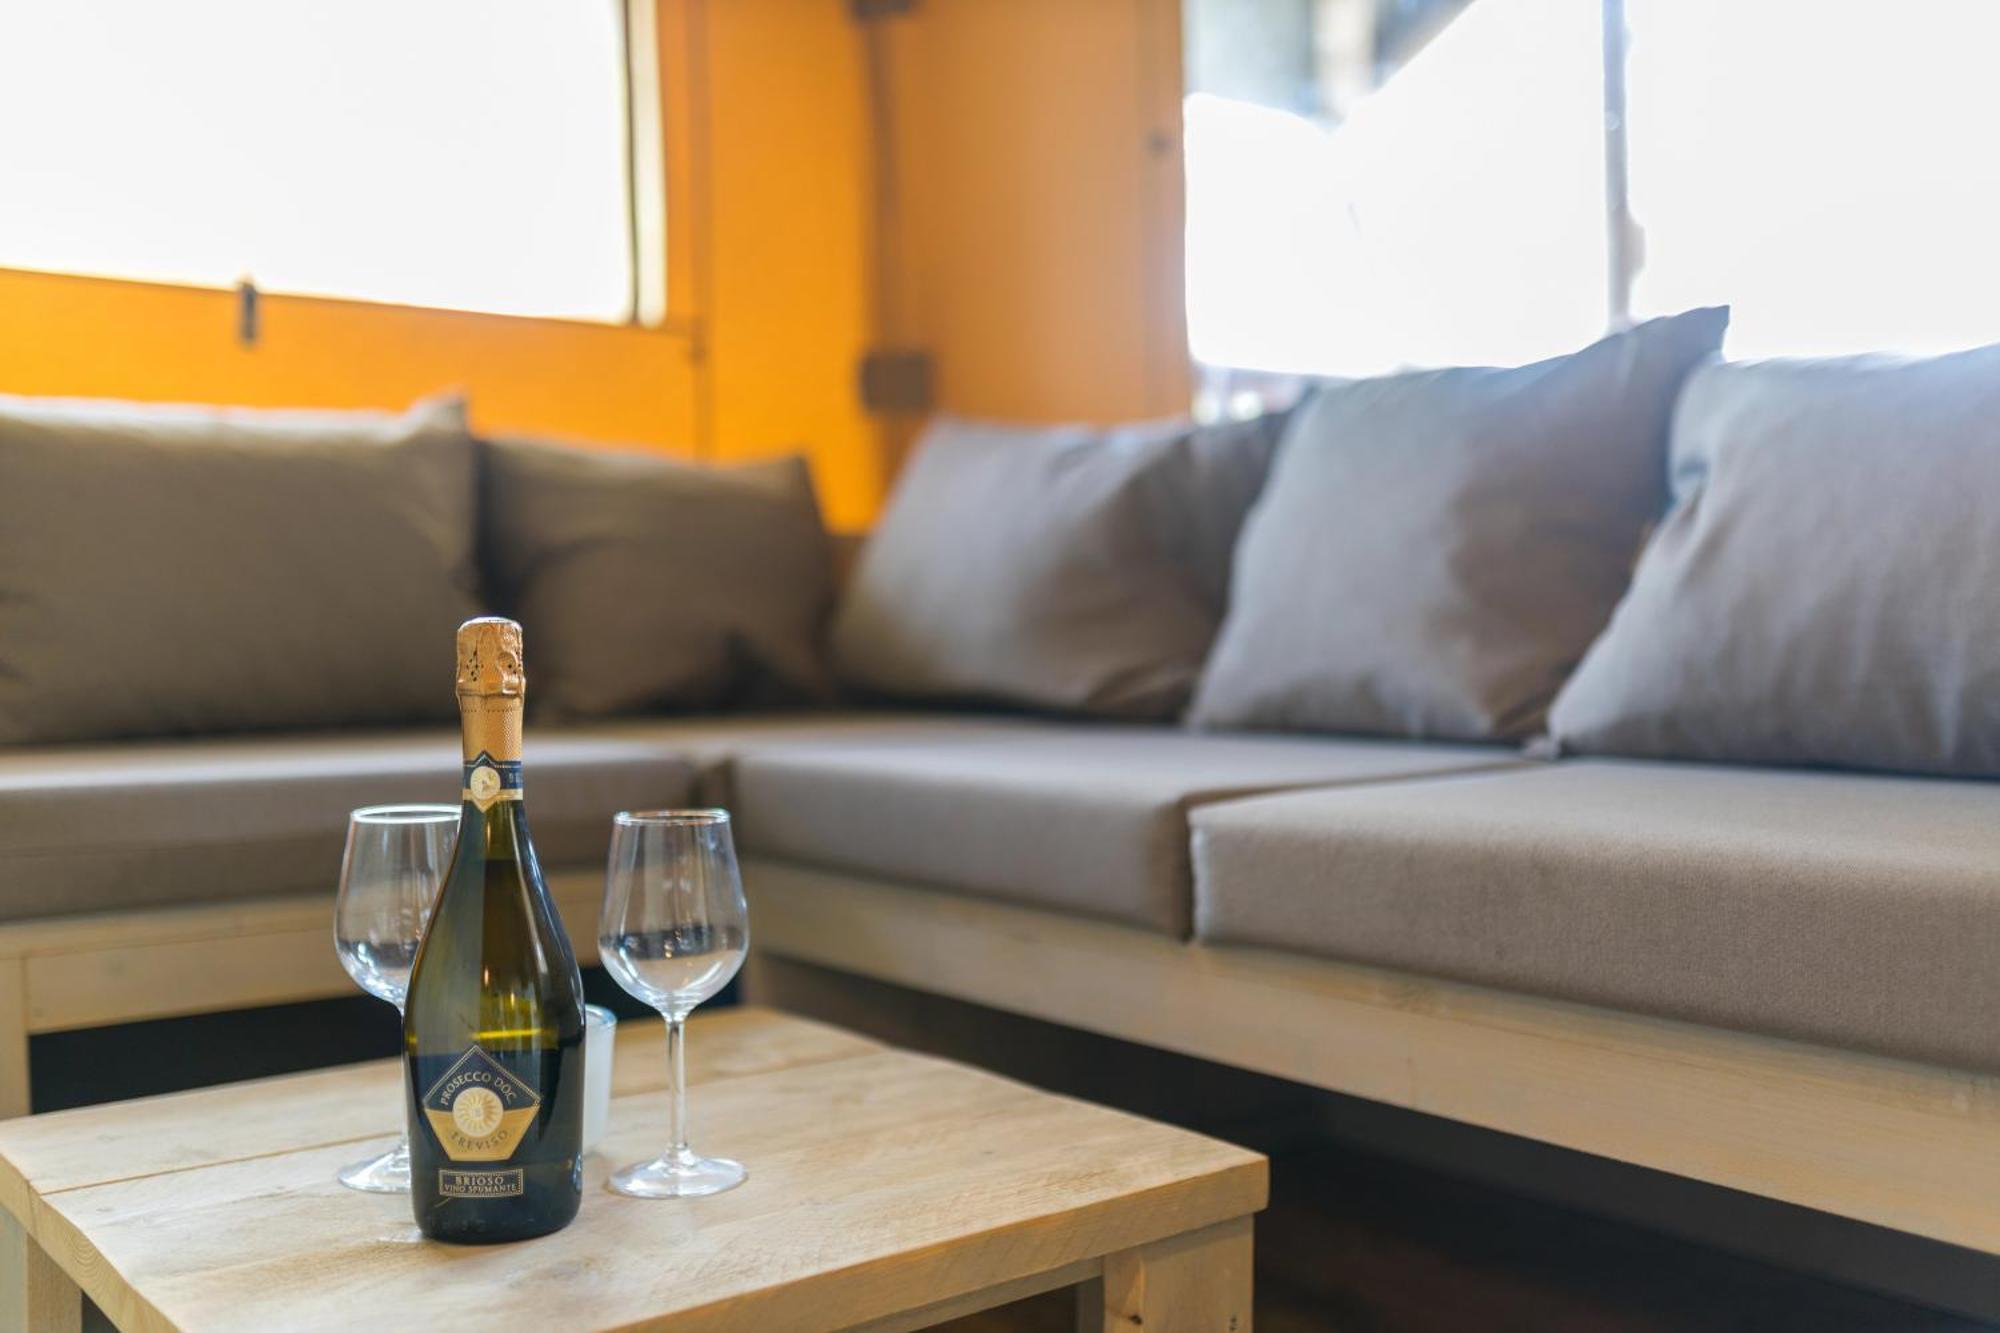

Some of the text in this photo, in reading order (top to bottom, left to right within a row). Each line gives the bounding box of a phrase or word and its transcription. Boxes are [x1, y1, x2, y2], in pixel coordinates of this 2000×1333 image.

[440, 1071, 517, 1106] PROSECCO DOC
[449, 1128, 509, 1150] TREVISO
[455, 1174, 504, 1186] BRIOSO
[444, 1184, 517, 1194] VINO SPUMANTE
